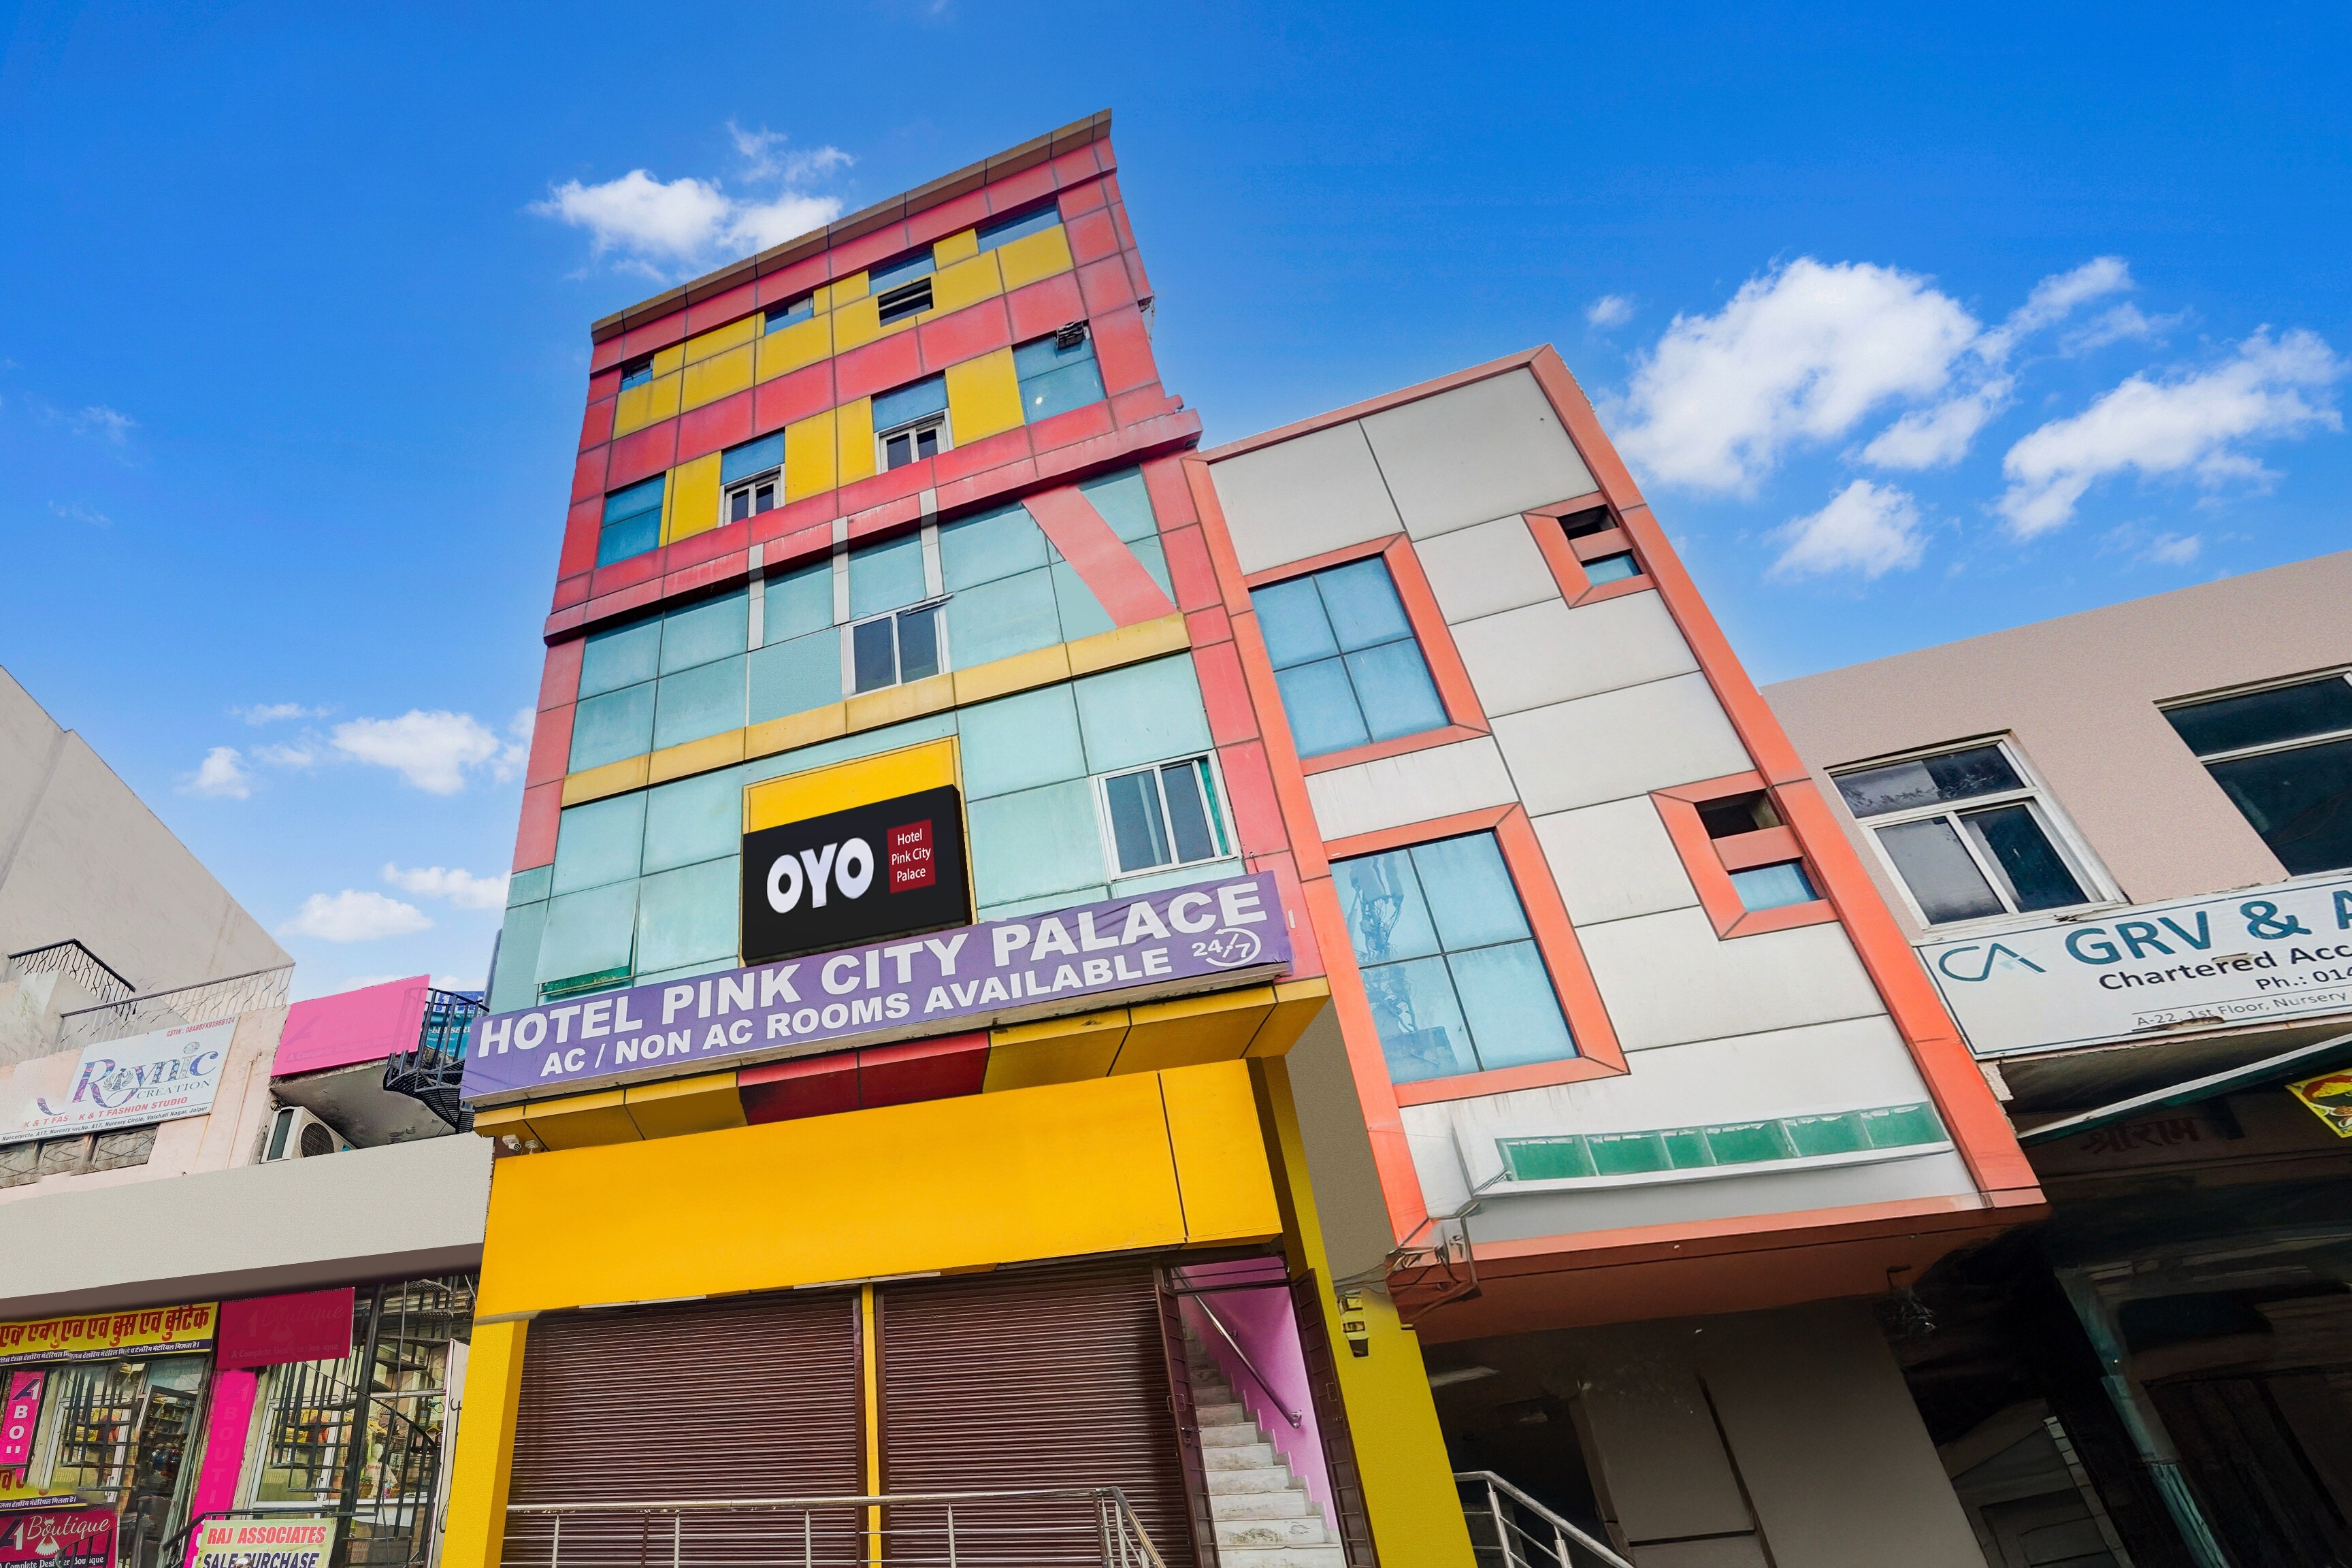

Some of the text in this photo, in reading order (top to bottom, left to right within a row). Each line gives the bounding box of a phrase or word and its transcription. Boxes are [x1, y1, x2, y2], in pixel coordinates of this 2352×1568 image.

[897, 828, 923, 846] Hotel
[892, 847, 931, 866] Pink City
[766, 837, 875, 913] OYO
[896, 868, 926, 883] Palace
[2065, 911, 2212, 966] GRV
[2239, 900, 2313, 940] &
[1192, 933, 1251, 958] 24/7
[478, 881, 1267, 1058] HOTEL PINK CITY PALACE
[2099, 951, 2278, 990] Chartered
[540, 1048, 586, 1077] AC
[615, 1028, 691, 1064] NON
[702, 1019, 753, 1049] AC
[766, 992, 911, 1040] ROOMS
[924, 948, 1172, 1014] AVAILABLE
[2218, 1002, 2270, 1015] Floor,
[2272, 992, 2346, 1007] Nursery
[166, 1028, 182, 1037] GSTIN
[137, 1079, 212, 1099] CREATION
[106, 1104, 148, 1116] FASHION
[151, 1096, 188, 1109] STUDIO
[147, 1112, 169, 1120] Vaishali
[189, 1106, 208, 1115] Jaipur
[27, 1515, 112, 1539] Boutique
[206, 1526, 327, 1545] RAJ ASSOCIATES
